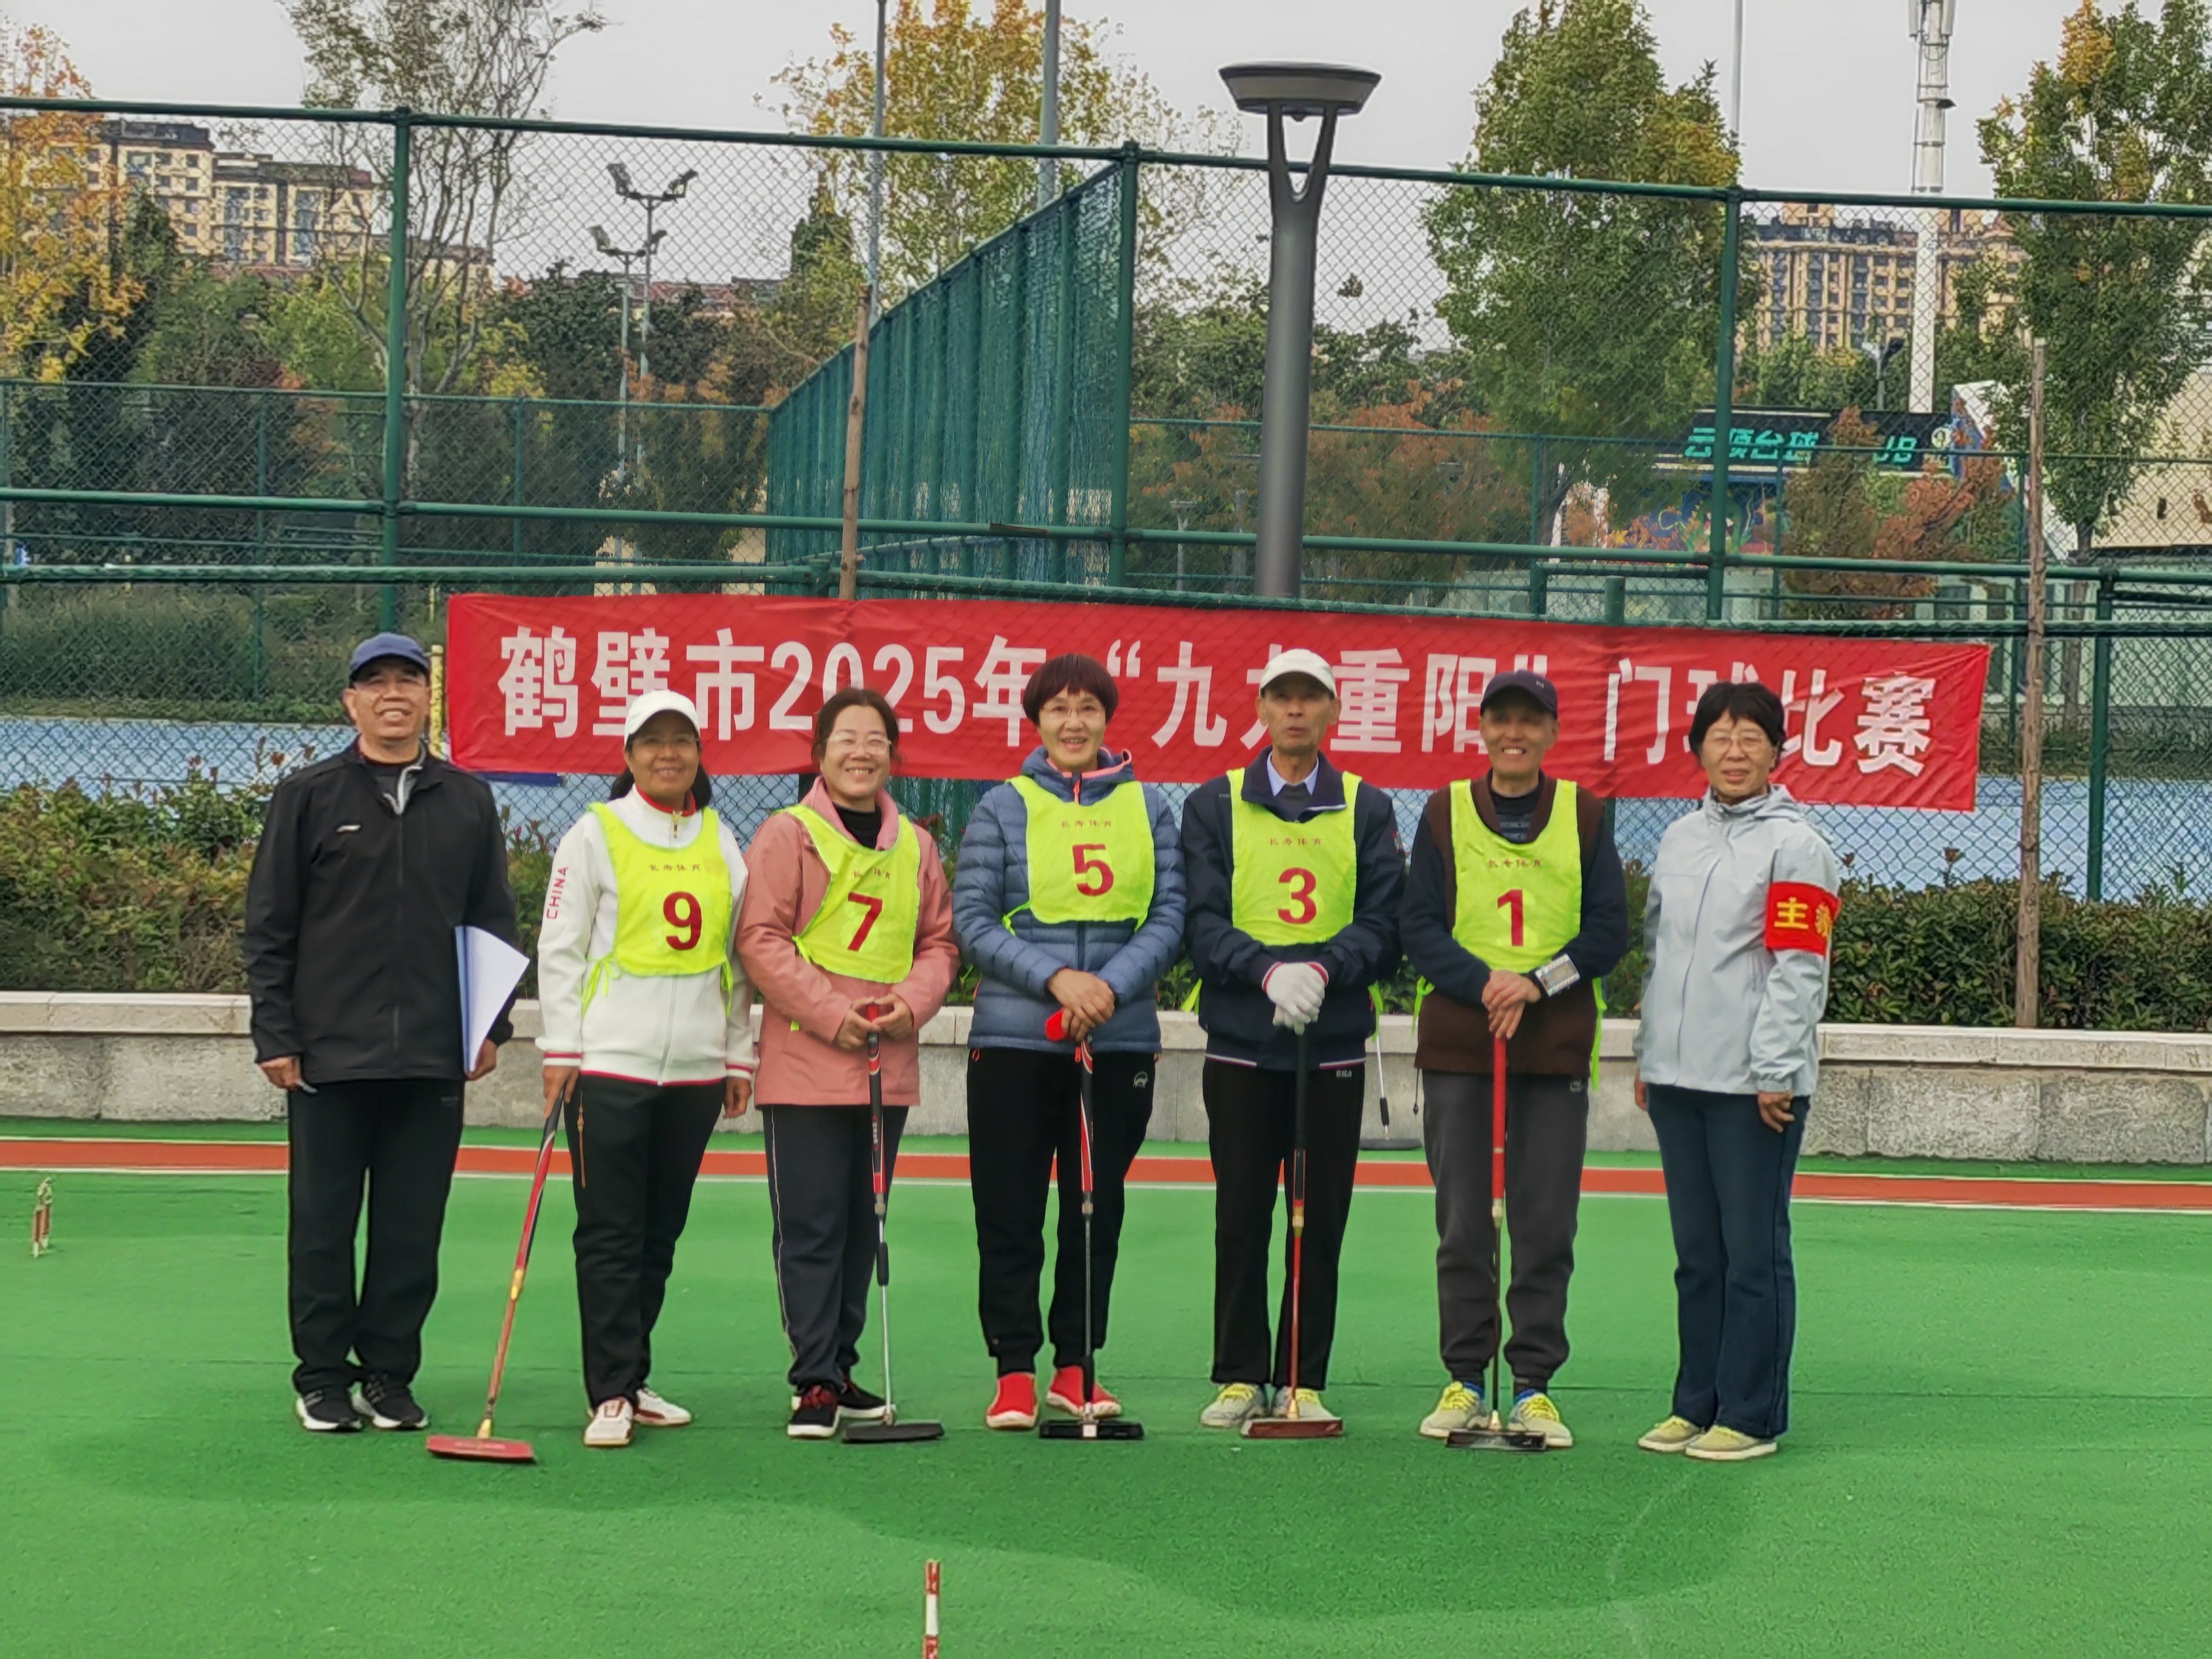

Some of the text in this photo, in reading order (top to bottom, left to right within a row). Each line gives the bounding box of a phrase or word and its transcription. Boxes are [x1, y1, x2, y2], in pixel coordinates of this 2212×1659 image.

[546, 866, 569, 920] CHINA
[1072, 844, 1114, 897] 5
[1277, 867, 1317, 925] 3
[663, 891, 702, 950] 9
[847, 892, 883, 953] 7
[1497, 889, 1524, 947] 1
